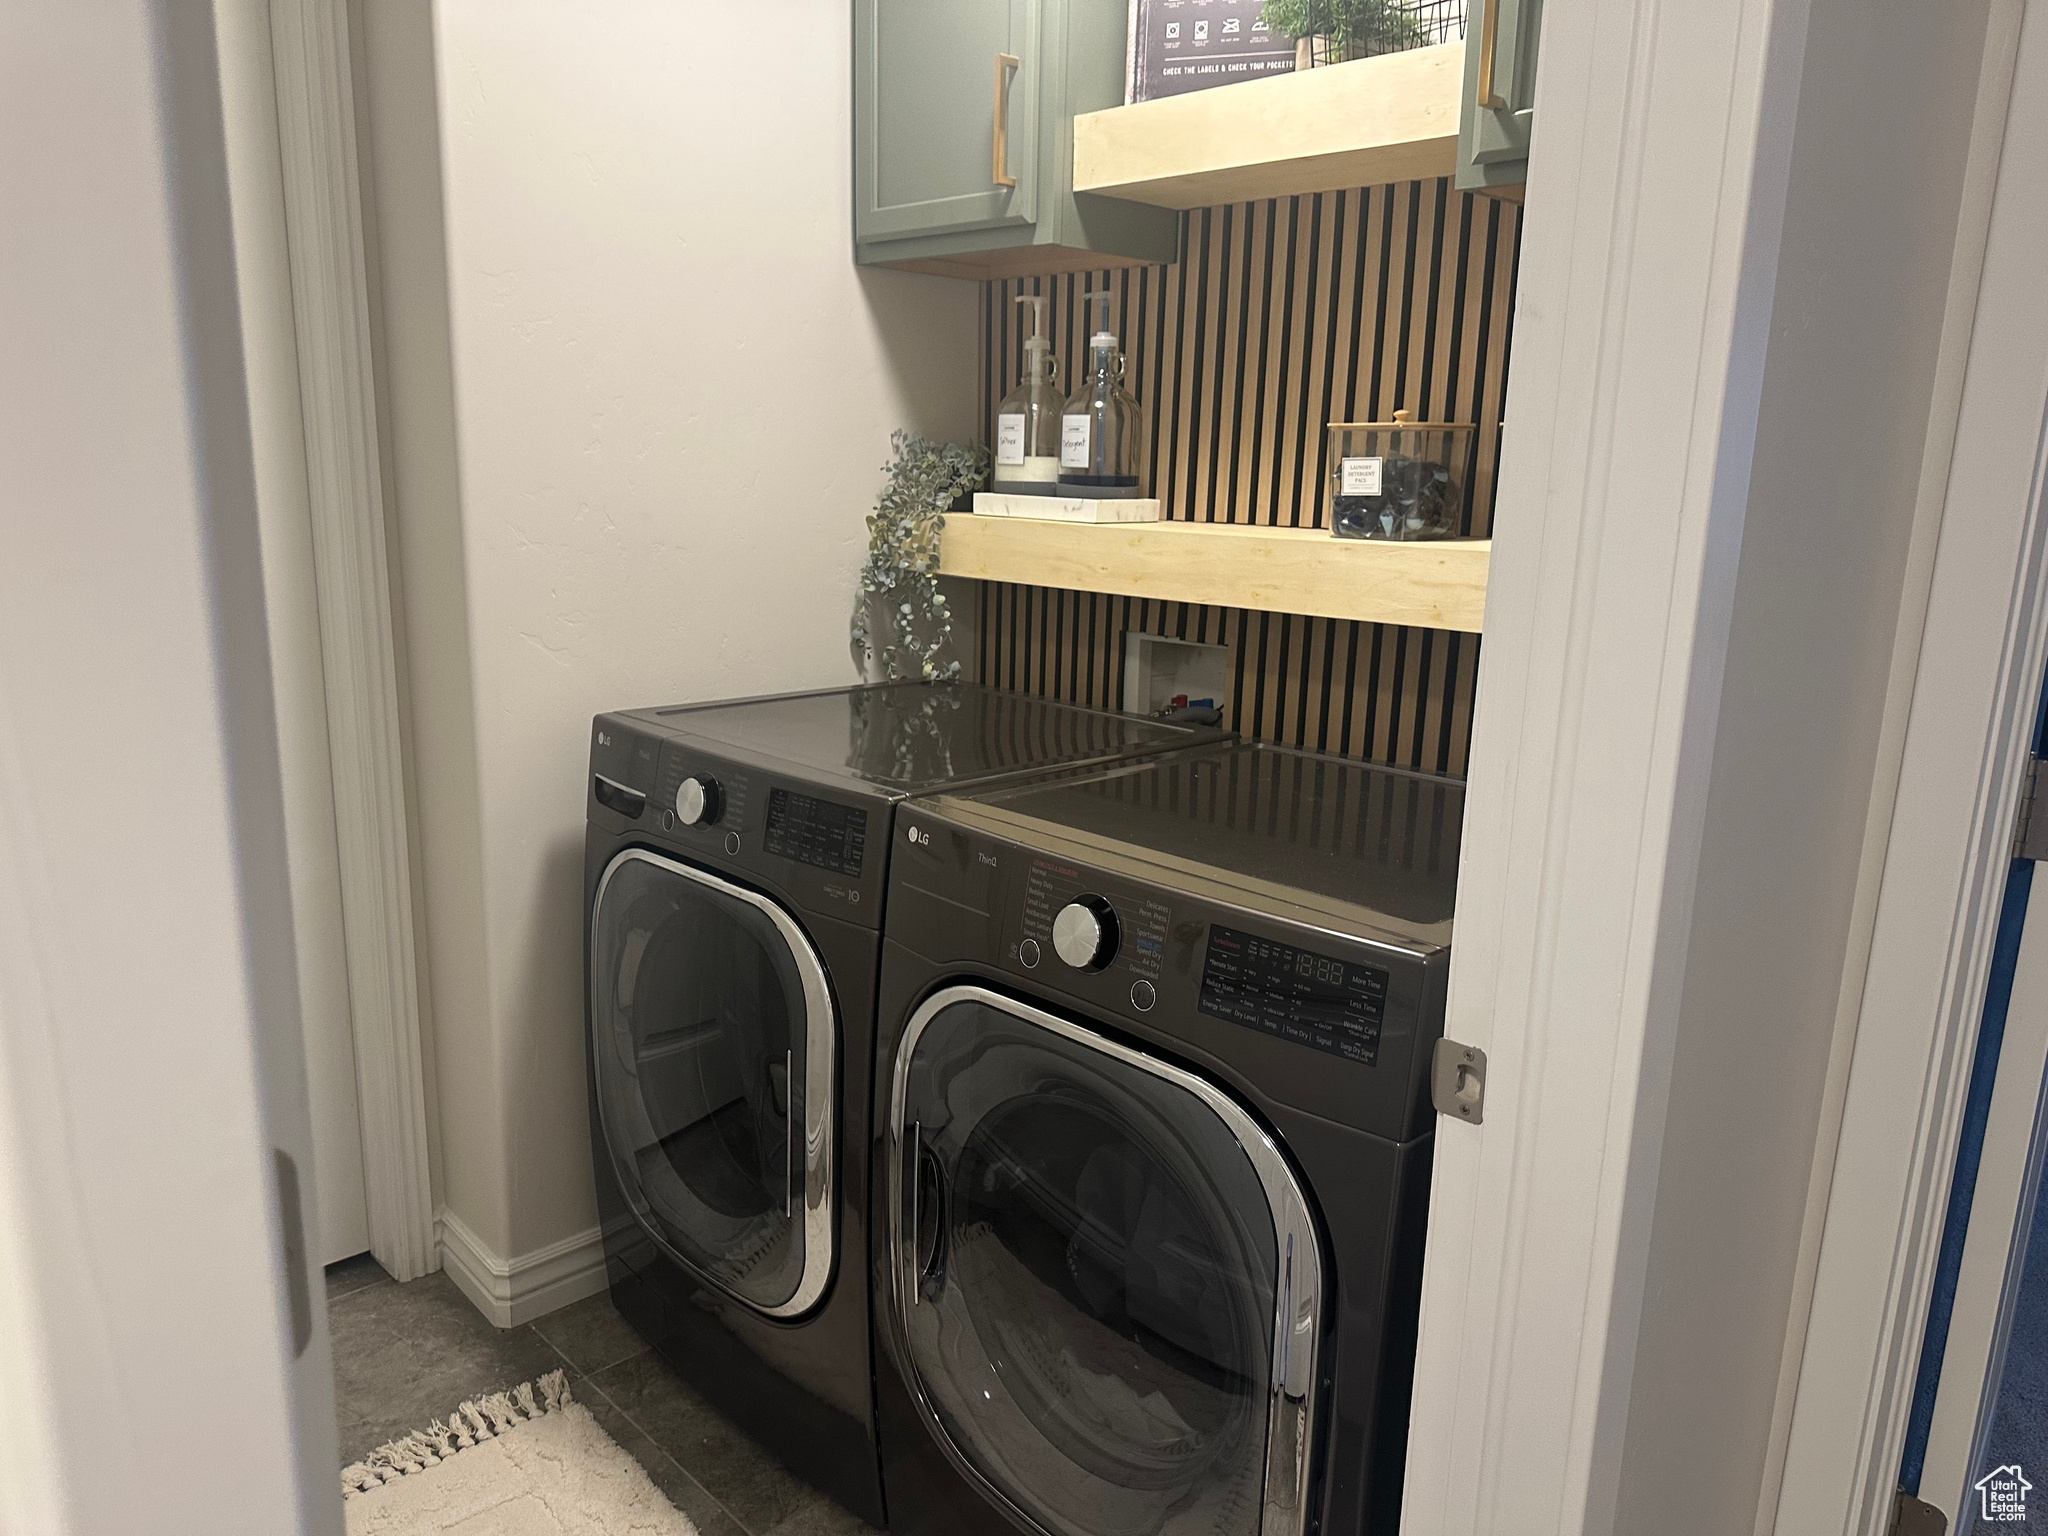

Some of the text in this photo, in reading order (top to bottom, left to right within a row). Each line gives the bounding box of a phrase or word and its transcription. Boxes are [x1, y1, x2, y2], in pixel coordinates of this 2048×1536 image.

[1163, 67, 1181, 76] CHECK
[1184, 66, 1195, 75] THE
[1198, 64, 1219, 74] LABELS
[1228, 62, 1247, 72] CHECK
[1249, 61, 1264, 70] YOUR
[918, 831, 930, 846] LG
[978, 852, 997, 867] ThinQ
[1146, 900, 1169, 913] Delicates
[1150, 921, 1165, 933] Towels
[1137, 945, 1161, 961] Speed Dry
[1142, 957, 1159, 972] Air Dry
[1226, 963, 1237, 972] Start
[1129, 964, 1159, 980] Downloaded
[1206, 978, 1221, 989] Reduce
[1352, 976, 1381, 989] More Time
[1202, 999, 1231, 1015] Energy Saver
[1349, 999, 1376, 1014] Less Time
[1234, 1010, 1256, 1023] Dry Level
[1264, 1019, 1278, 1030] Temp.
[1343, 1020, 1377, 1037] Wrinkle Care
[1286, 1026, 1309, 1040] Time Dry
[1316, 1035, 1332, 1047] Signal
[1340, 1042, 1352, 1052] Damp
